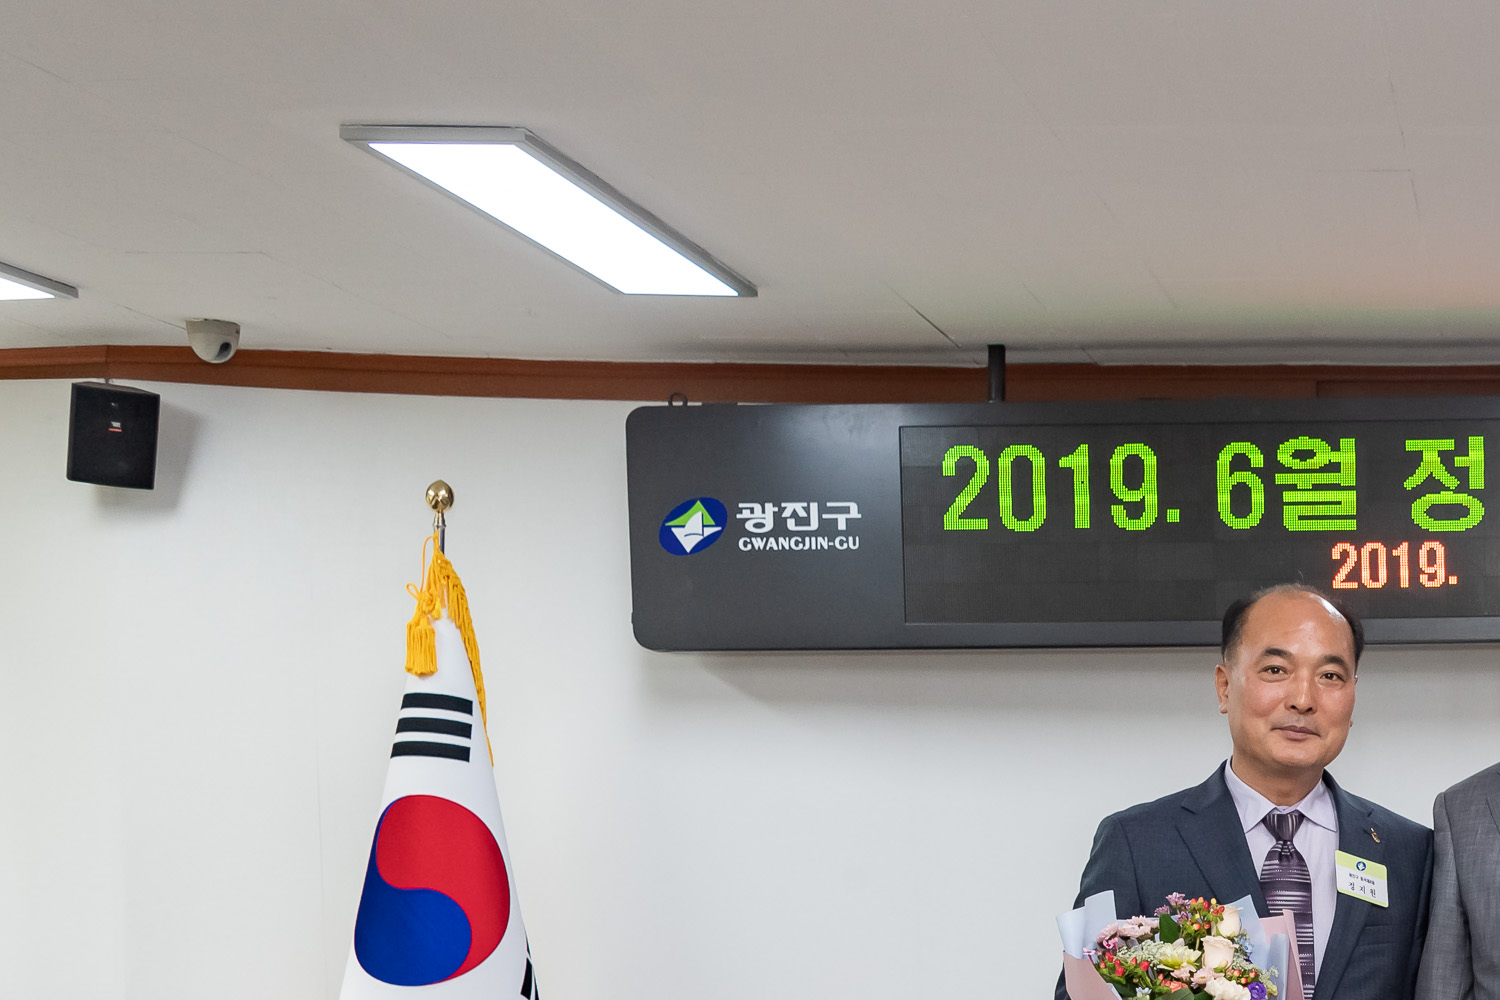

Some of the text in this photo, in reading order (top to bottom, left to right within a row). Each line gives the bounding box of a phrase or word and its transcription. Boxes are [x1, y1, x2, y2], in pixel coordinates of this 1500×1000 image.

[941, 443, 1181, 532] 2019.
[1217, 435, 1358, 531] 6월
[736, 501, 862, 534] 광진구
[738, 535, 860, 552] GWANGJIN-GU
[1331, 540, 1459, 590] 2019.
